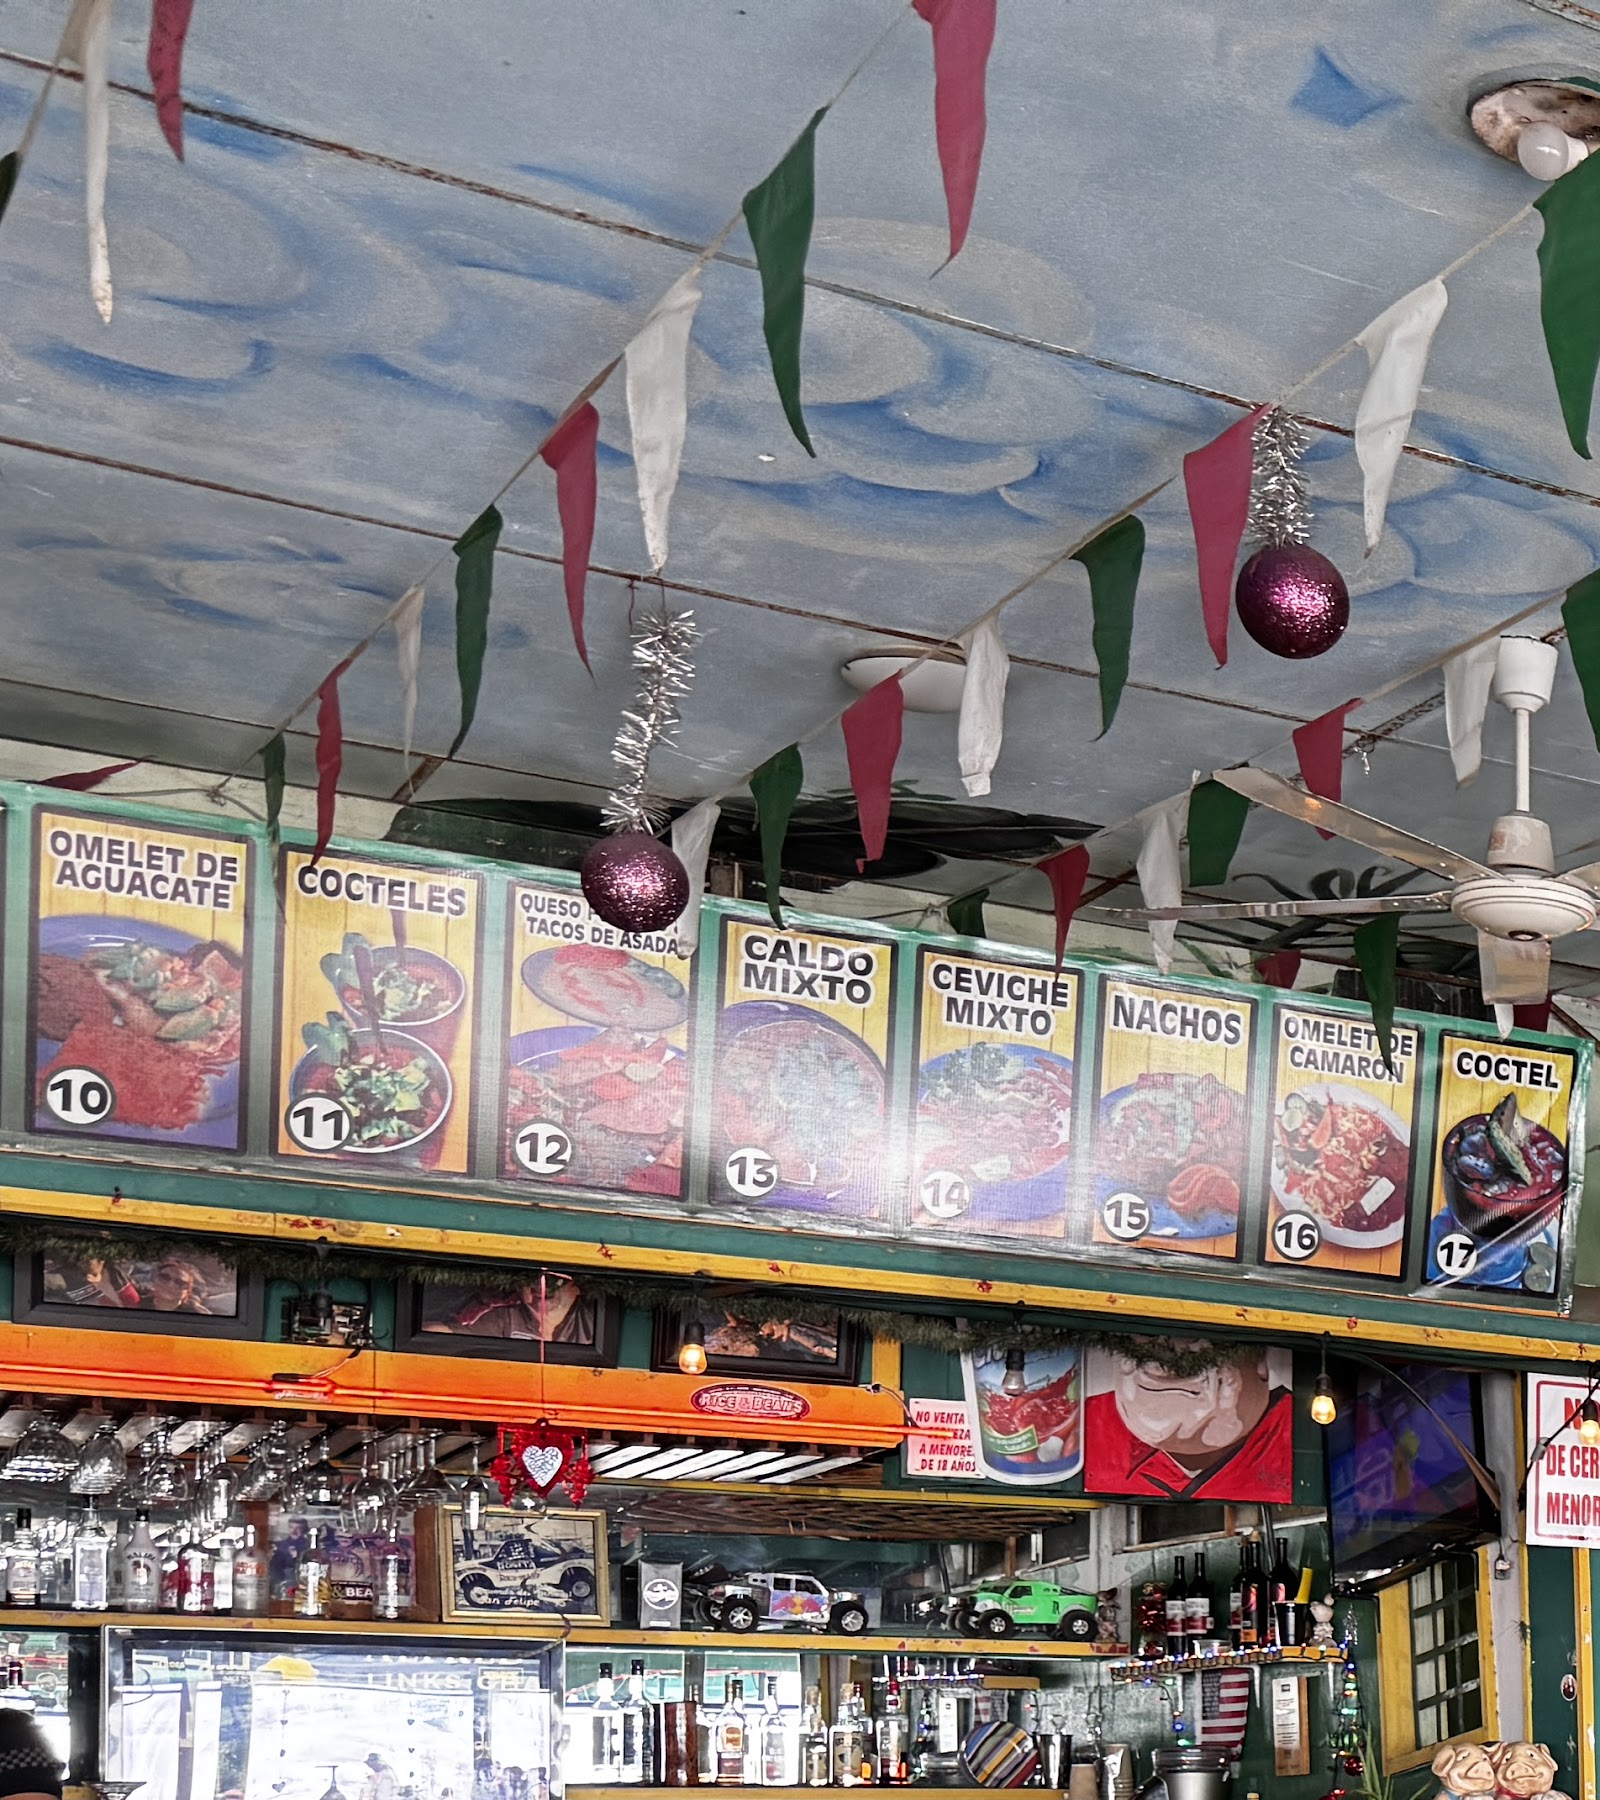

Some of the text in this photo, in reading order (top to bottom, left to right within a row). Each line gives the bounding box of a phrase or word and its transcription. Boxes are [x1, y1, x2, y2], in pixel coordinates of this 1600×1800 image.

[50, 830, 239, 883] OMELET DE
[56, 858, 233, 910] AGUACATE
[296, 863, 467, 917] COCTELES
[521, 894, 581, 918] QUESO
[526, 916, 678, 955] TACOS DE ASADA
[744, 935, 874, 976] CALDO
[743, 963, 872, 1004] MIXTO
[933, 962, 1070, 1009] CEVICHE
[945, 996, 1053, 1038] MIXTO
[1113, 994, 1242, 1047] NACHOS
[1284, 1017, 1413, 1057] OMELET DE
[1456, 1051, 1559, 1089] COCTEL
[49, 1078, 107, 1116] 10
[292, 1107, 351, 1143] 11
[516, 1132, 571, 1166] 12
[727, 1156, 775, 1186] 13
[922, 1179, 967, 1210] 14
[1104, 1201, 1149, 1231] 15
[1277, 1221, 1316, 1250] 16
[1439, 1241, 1475, 1268] 17
[700, 1392, 736, 1410] RICE
[752, 1395, 803, 1414] BEANS
[916, 1411, 965, 1424] NO VENTA
[919, 1444, 926, 1454] A
[921, 1459, 935, 1471] DE
[937, 1459, 948, 1471] 18
[1546, 1444, 1566, 1477] DE
